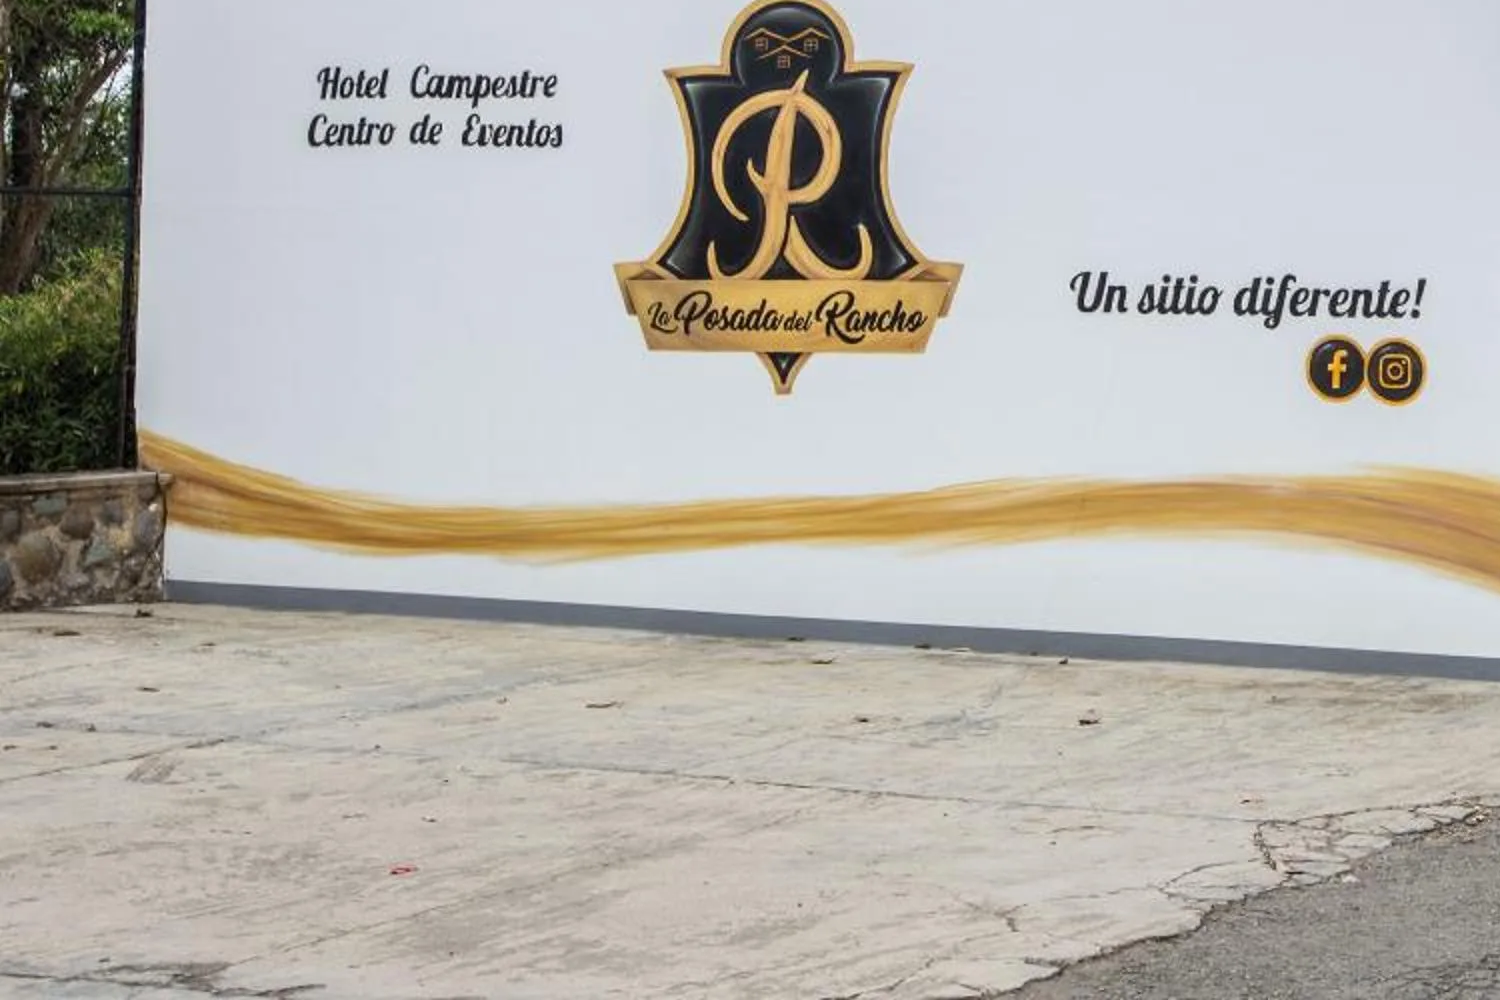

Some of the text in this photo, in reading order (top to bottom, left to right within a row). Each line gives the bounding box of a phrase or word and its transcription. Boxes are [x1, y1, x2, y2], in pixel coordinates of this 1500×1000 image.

[317, 63, 558, 109] Hotel Campestre
[307, 113, 563, 148] Centro de Eventos
[673, 290, 781, 335] Posada
[784, 305, 812, 331] del
[815, 290, 927, 344] Rancho
[1069, 271, 1426, 330] Un sitio diferente!
